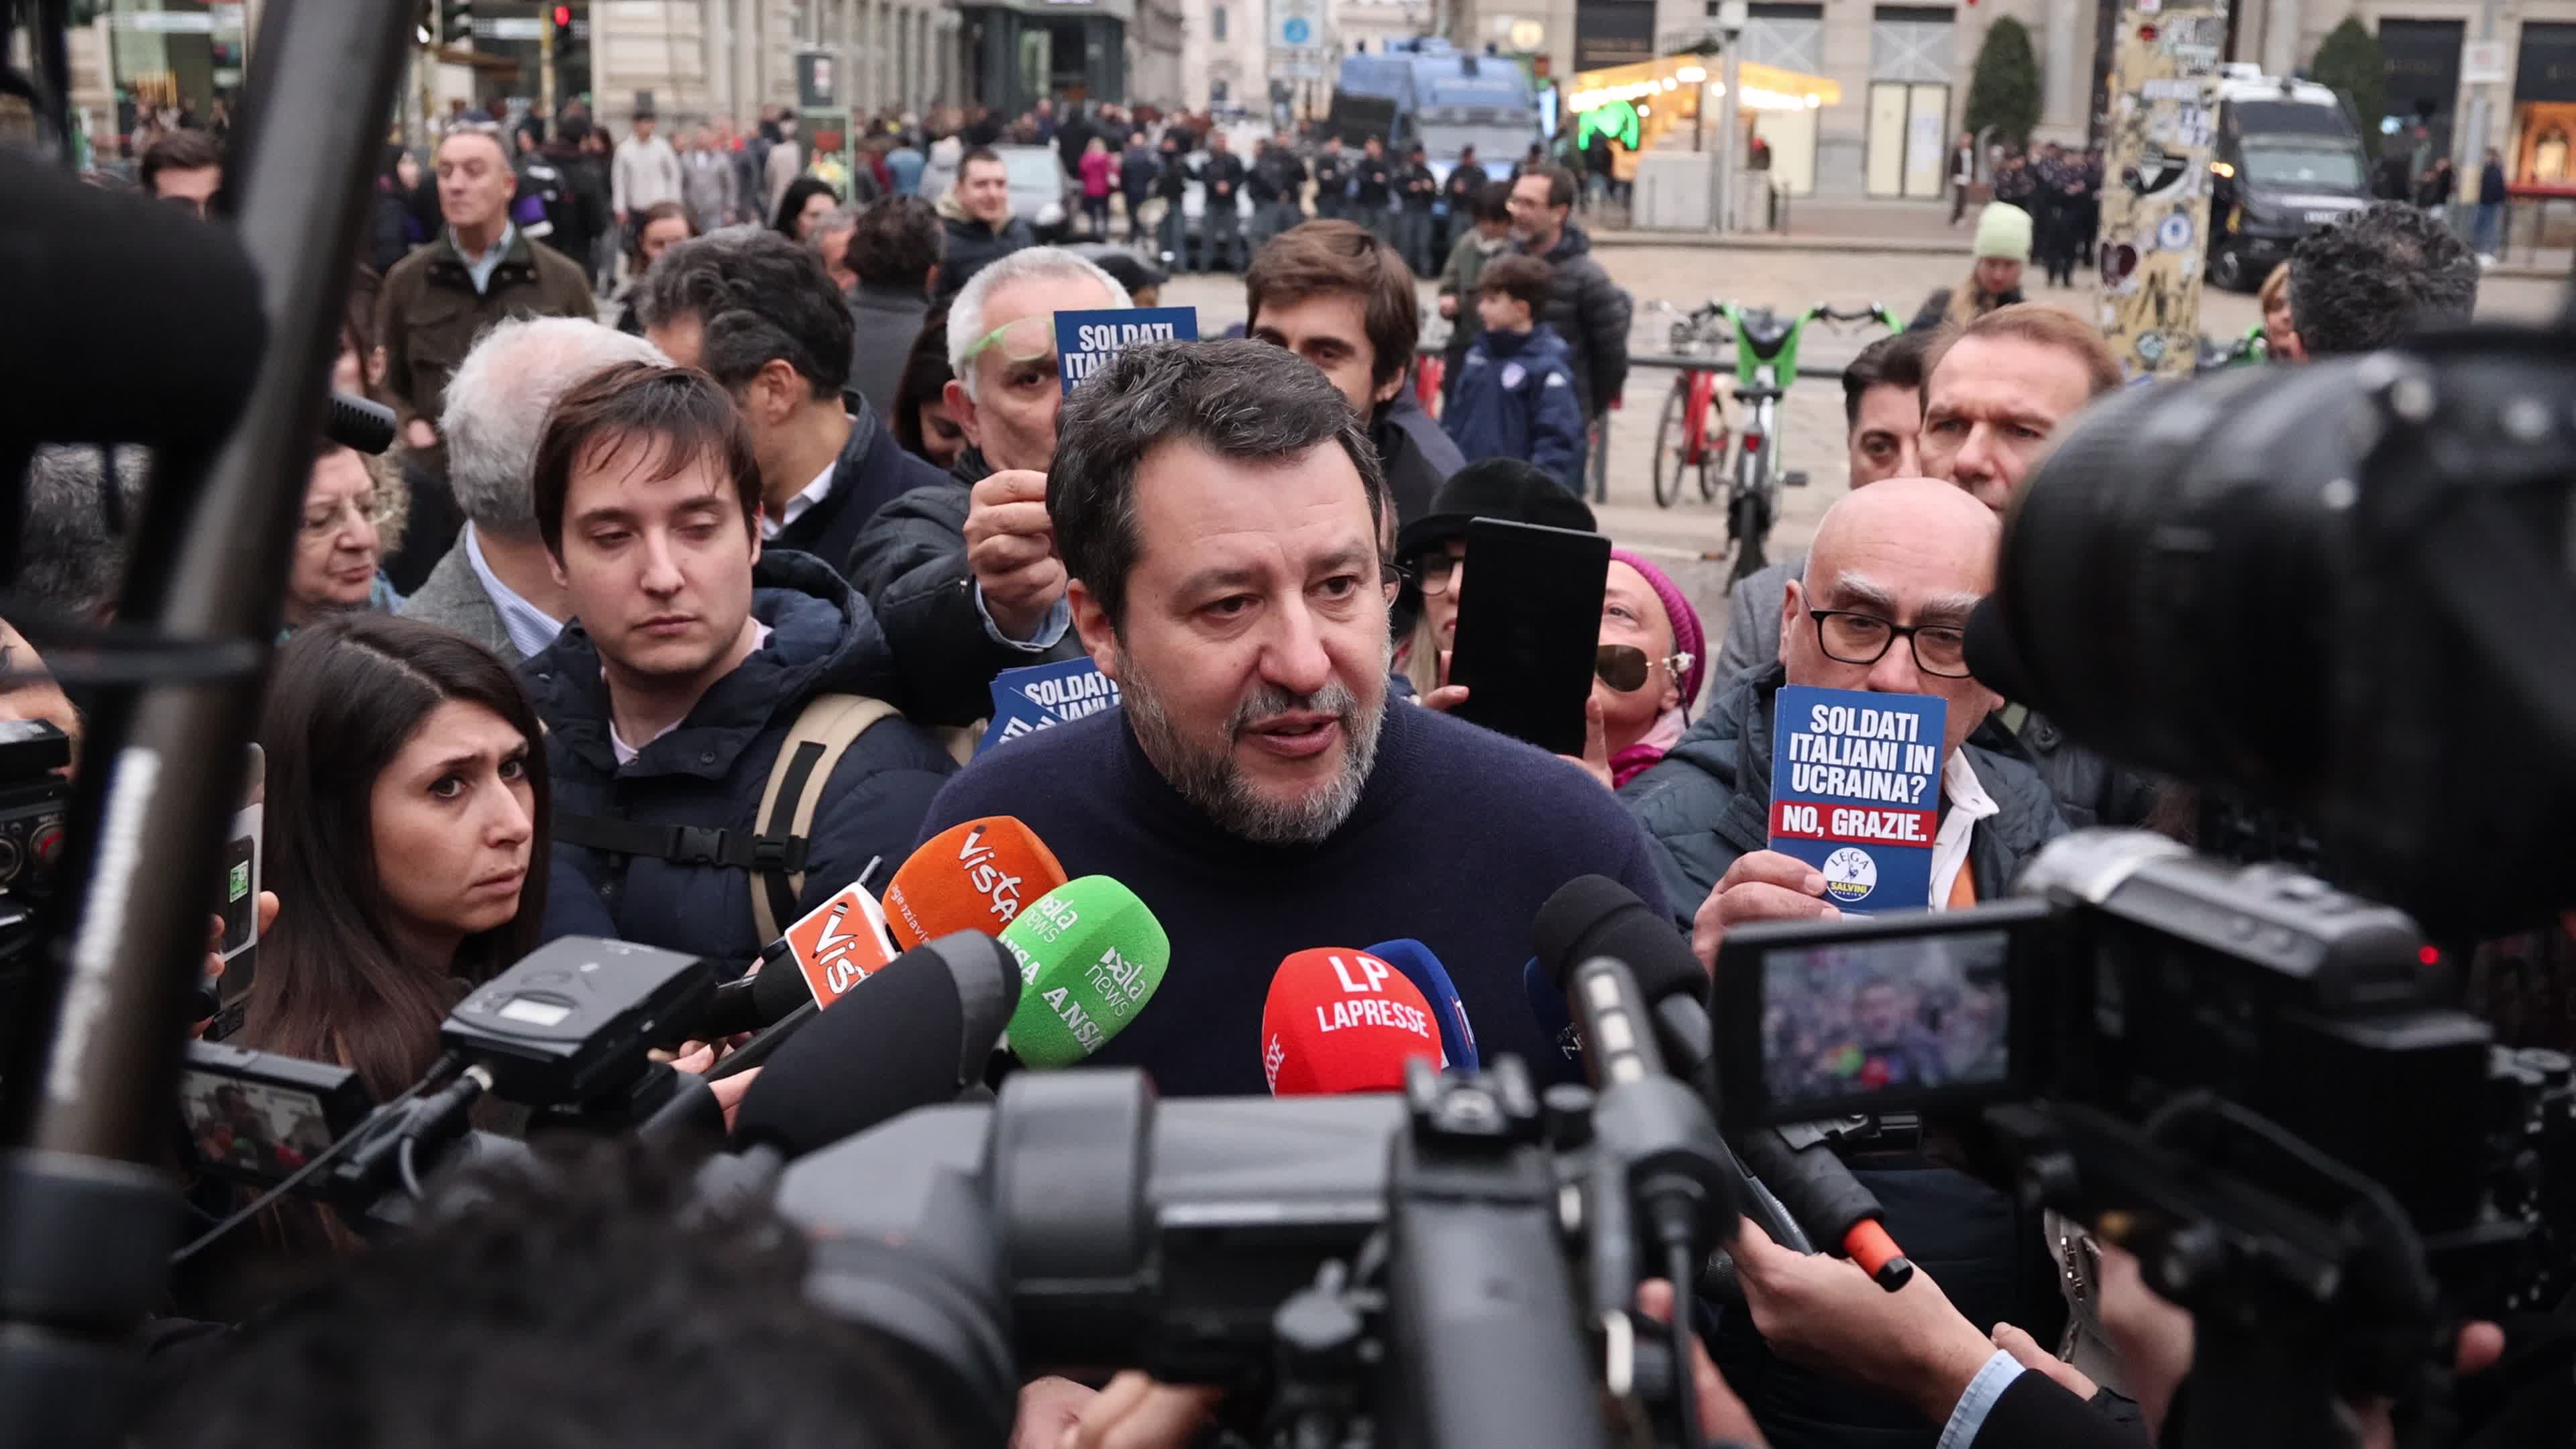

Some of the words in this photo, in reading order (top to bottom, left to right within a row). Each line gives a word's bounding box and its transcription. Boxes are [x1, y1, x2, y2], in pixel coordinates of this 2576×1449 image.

[1079, 323, 1173, 352] SOLDATI
[1810, 704, 1919, 743] SOLDATI
[1788, 732, 1898, 771] ITALIANI
[1904, 744, 1935, 775] IN
[1791, 763, 1927, 804] UCRAINA?
[1782, 804, 1825, 838] NO,
[1831, 808, 1927, 842] GRAZIE.
[1831, 851, 1870, 870] LEGA
[1830, 881, 1868, 894] SALVINI
[1085, 964, 1130, 1018] news
[1328, 955, 1390, 993] LP
[1316, 998, 1430, 1039] LAPRESSE
